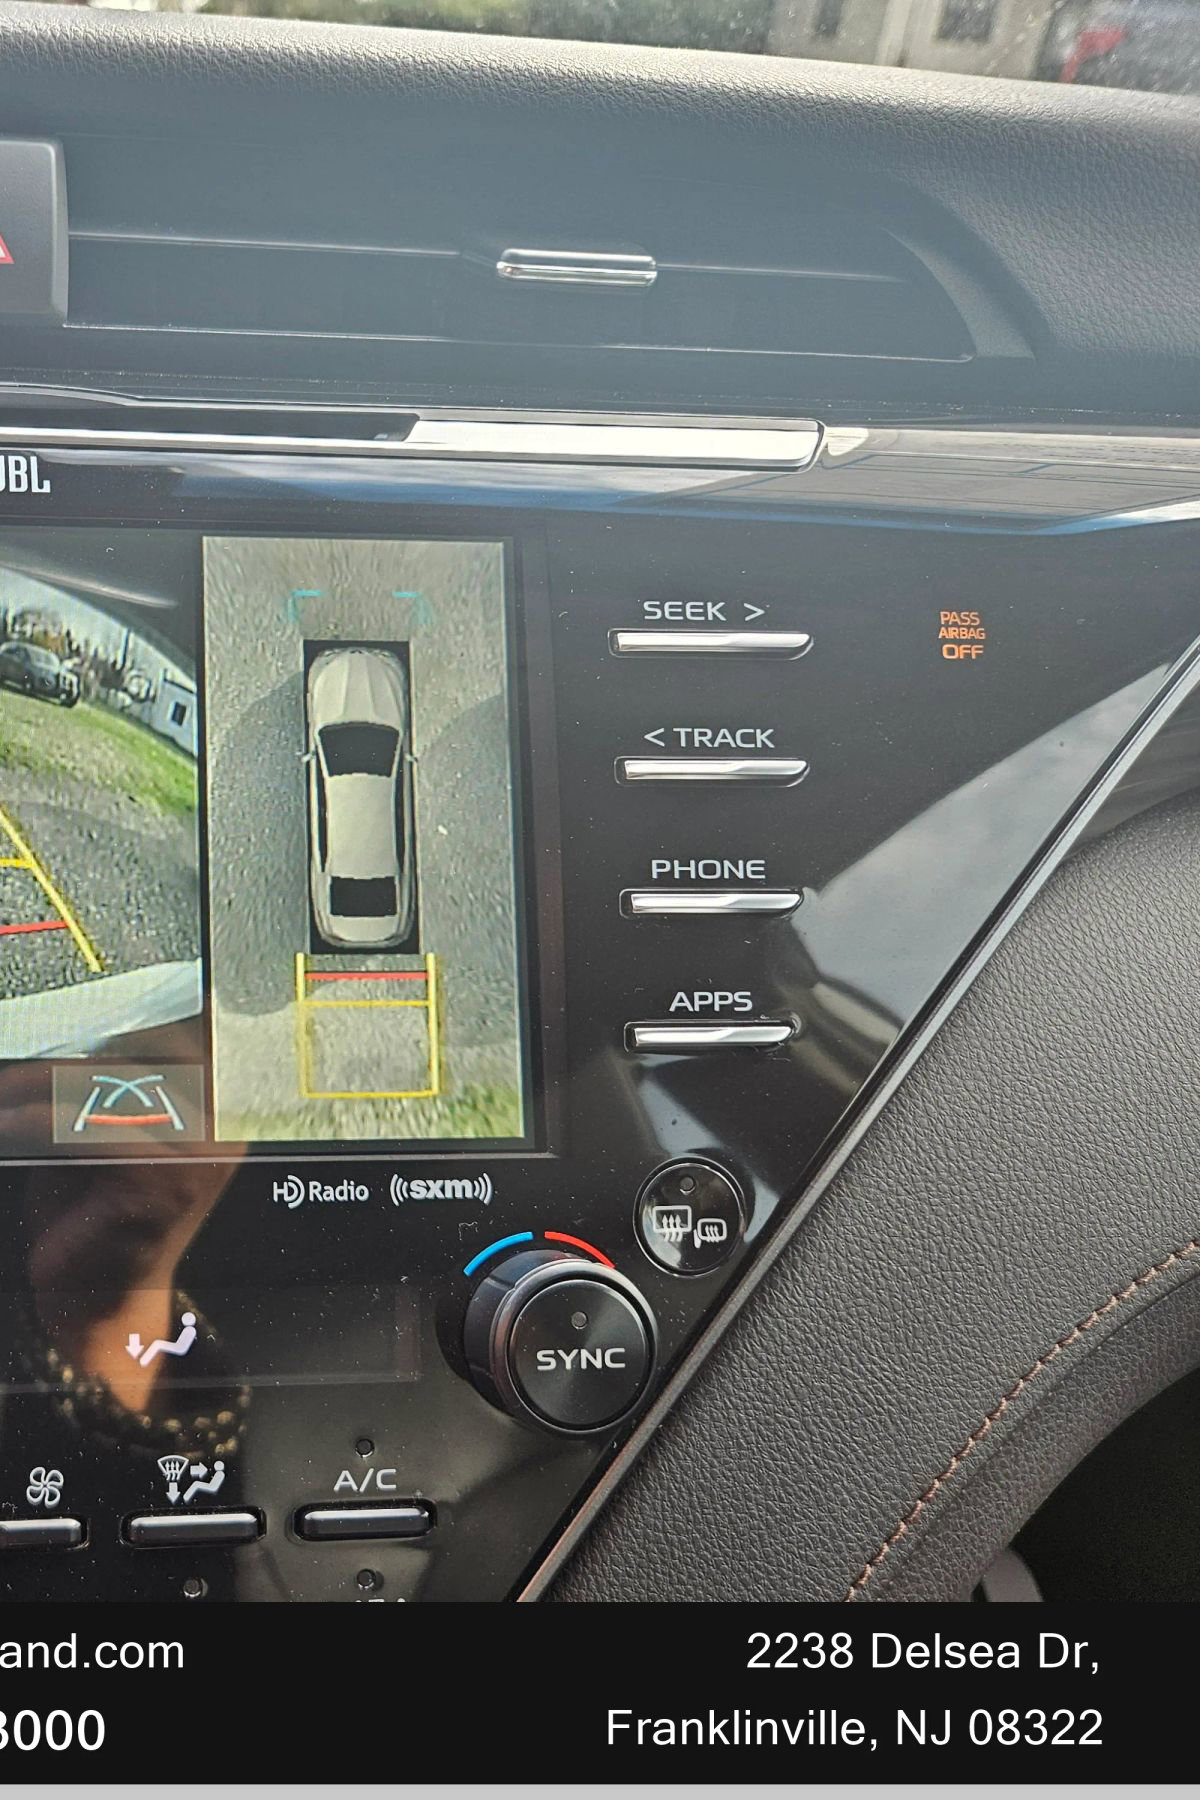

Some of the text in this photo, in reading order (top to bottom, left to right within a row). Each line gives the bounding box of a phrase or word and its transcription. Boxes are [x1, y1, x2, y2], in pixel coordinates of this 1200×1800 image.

[643, 600, 727, 621] SEEK
[940, 611, 980, 625] PASS
[938, 626, 986, 640] AIRBAG
[942, 643, 984, 660] OFF
[672, 727, 775, 748] TRACK
[650, 859, 766, 880] PHONE
[669, 991, 753, 1012] APPS
[309, 1179, 370, 1202] Radio
[536, 1347, 626, 1371] SYNC
[333, 1468, 397, 1493] A/C
